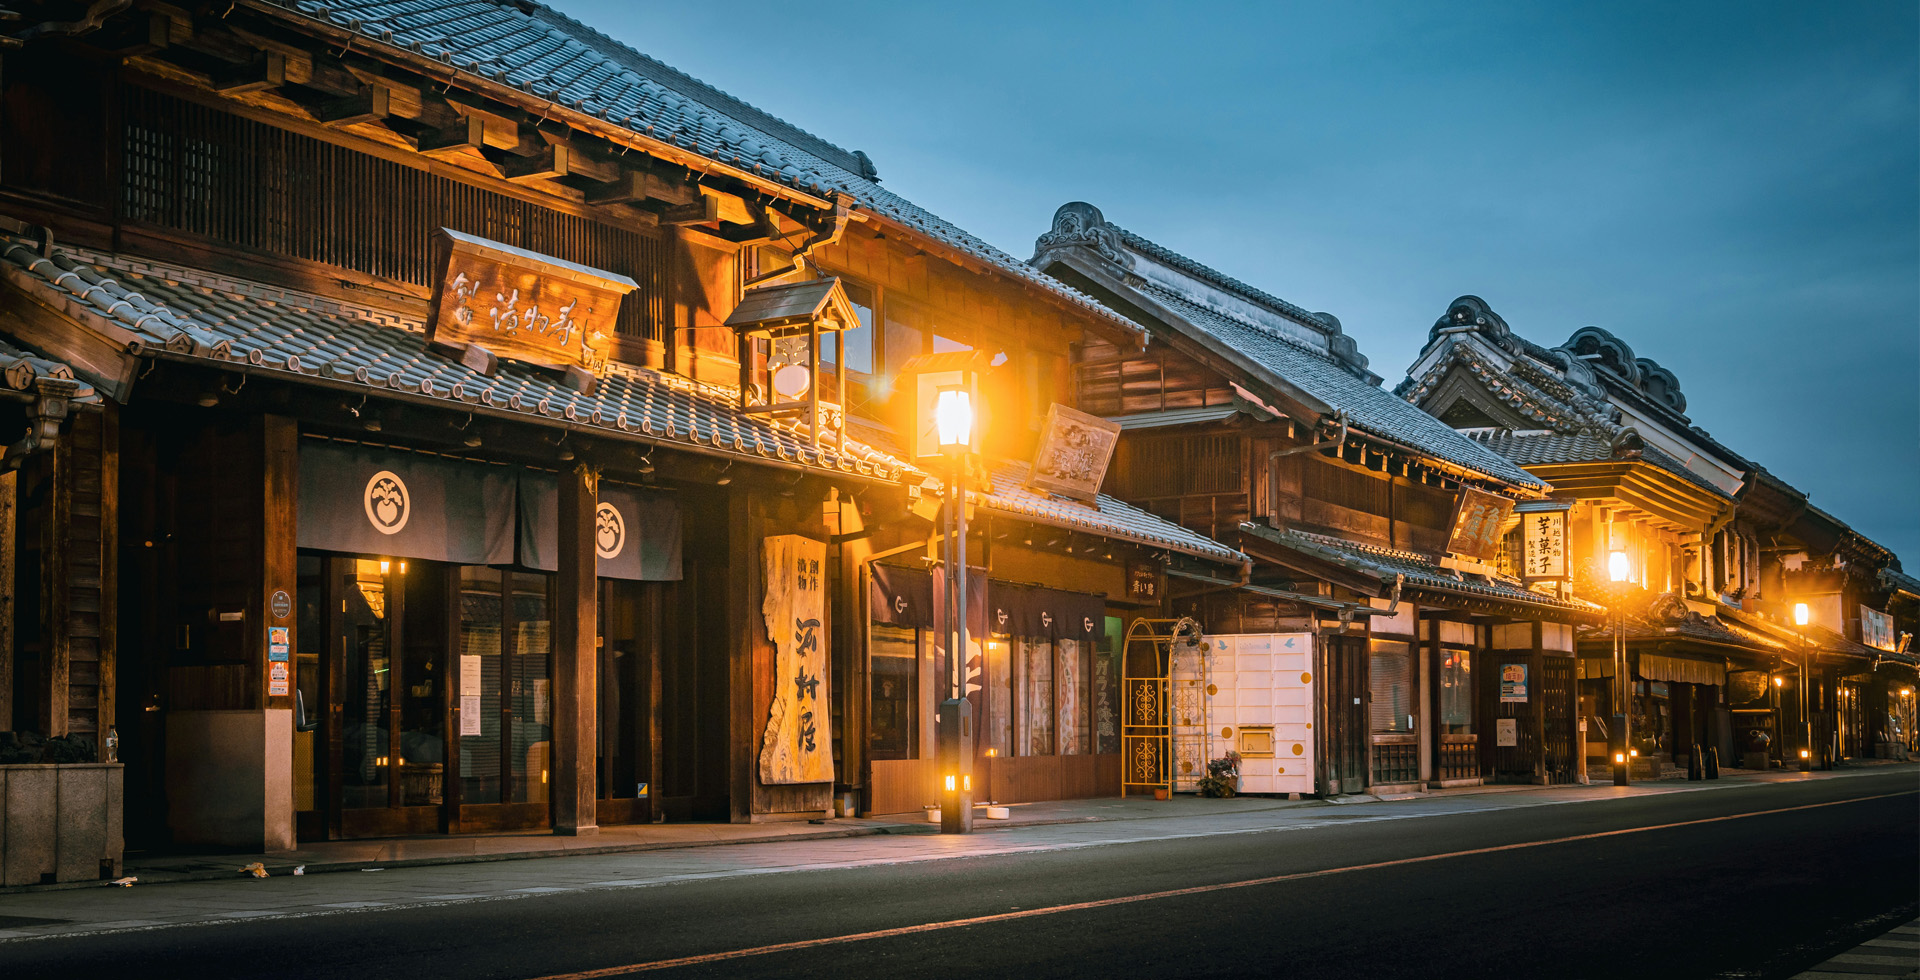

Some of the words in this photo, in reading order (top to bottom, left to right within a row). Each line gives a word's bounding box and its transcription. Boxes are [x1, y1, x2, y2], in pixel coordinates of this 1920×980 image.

[1537, 516, 1551, 574] 芋菓子
[1553, 517, 1561, 557] 川越名物
[797, 558, 807, 591] 漬物
[810, 559, 819, 592] 創作
[1133, 580, 1155, 596] 青い鳥
[794, 617, 820, 753] 河村屋
[1096, 660, 1115, 737] ガラス体験
